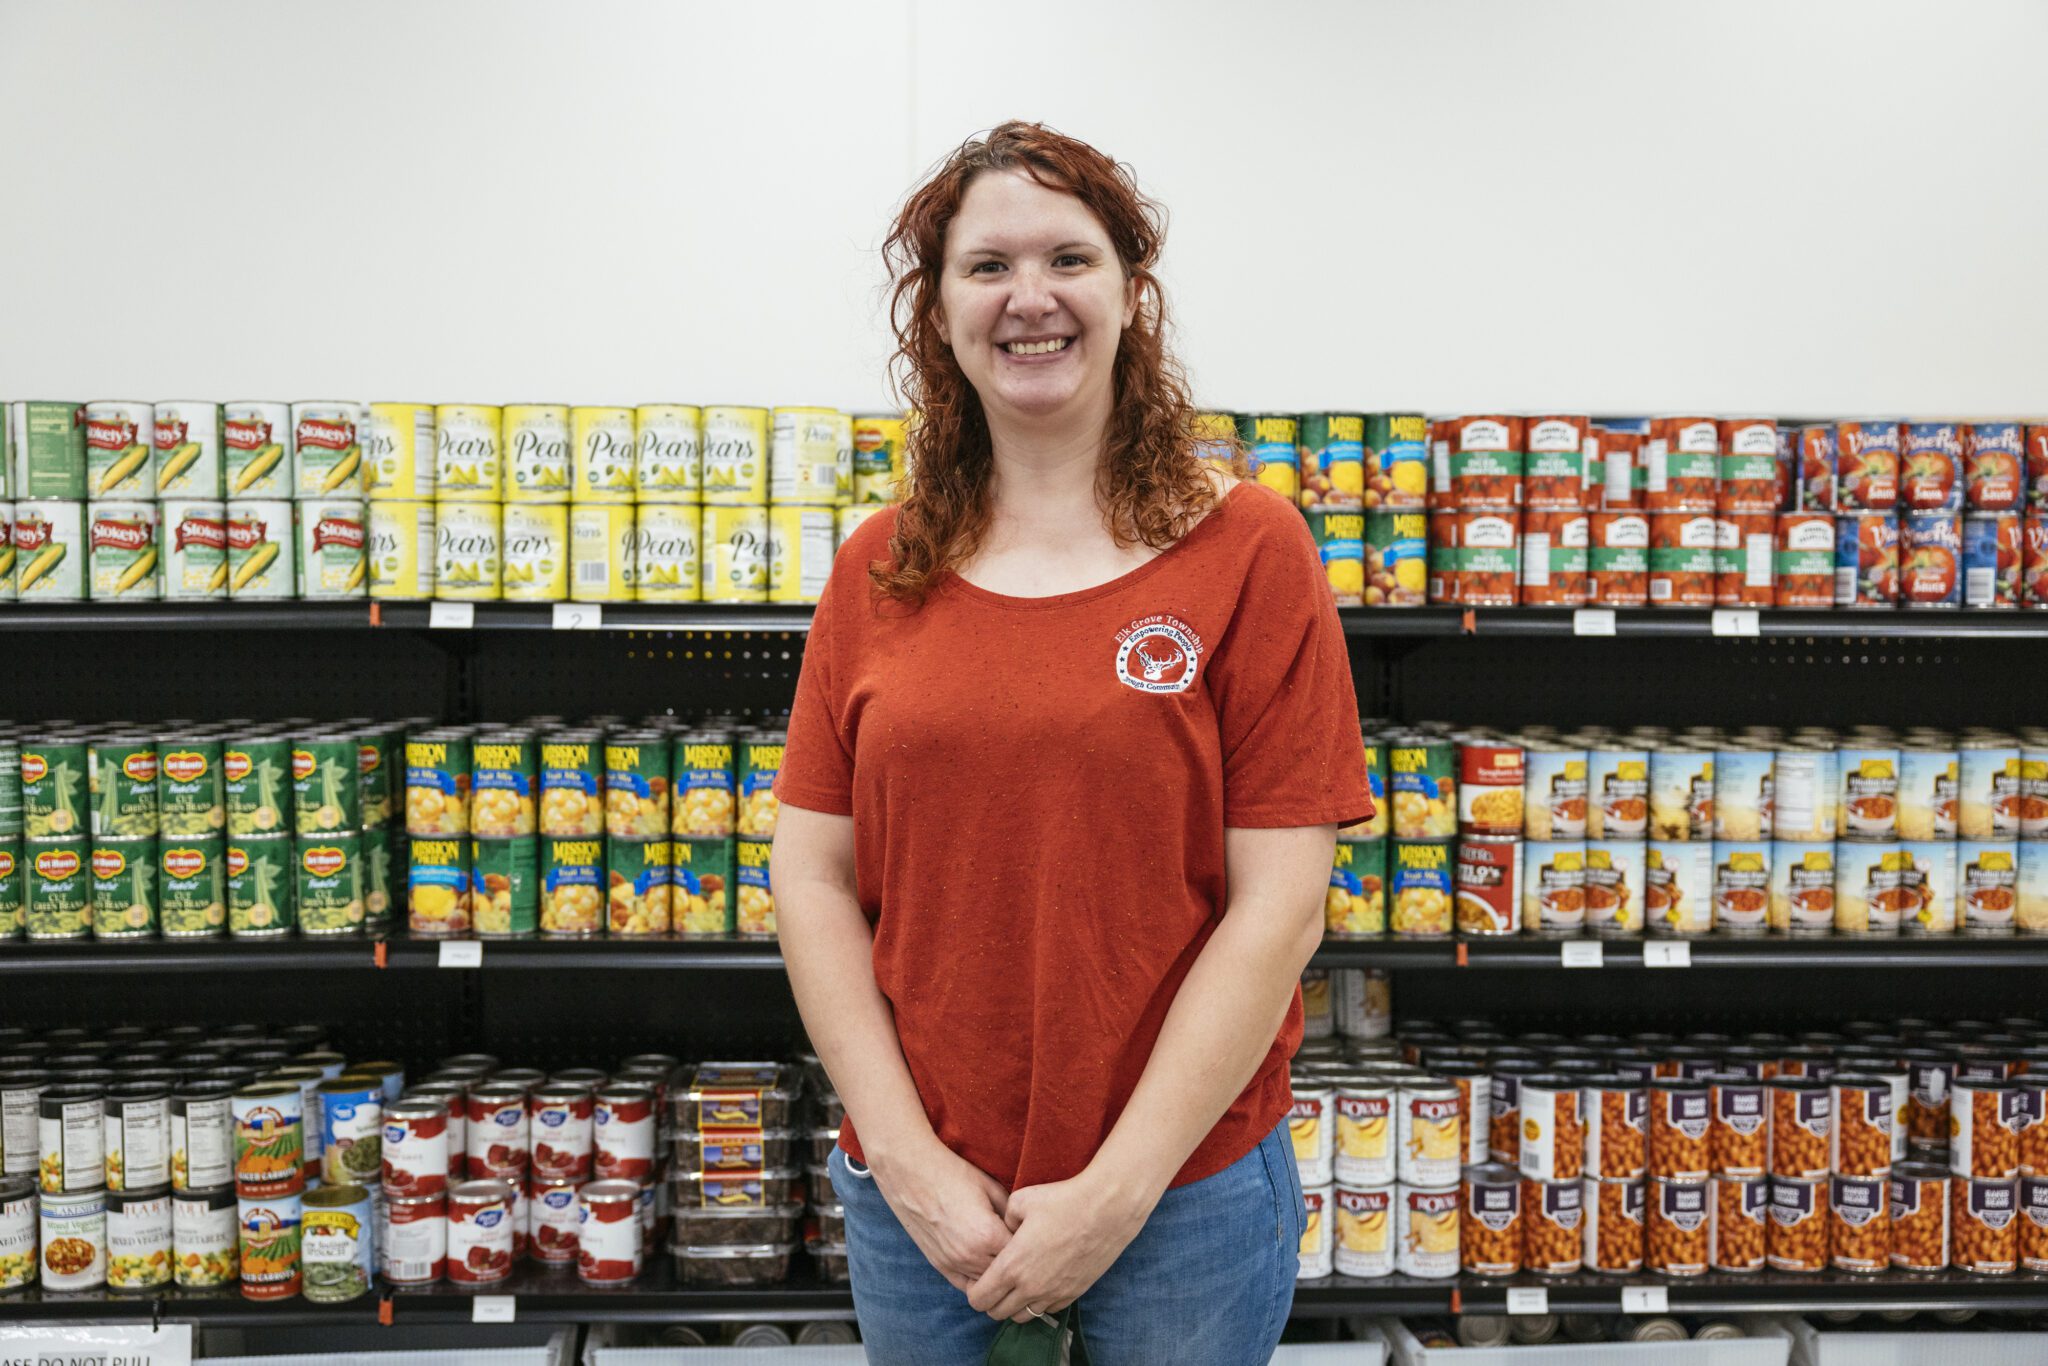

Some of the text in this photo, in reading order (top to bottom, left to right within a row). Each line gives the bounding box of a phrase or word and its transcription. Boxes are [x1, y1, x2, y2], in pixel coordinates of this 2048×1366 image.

[436, 429, 496, 461] Pears
[514, 430, 569, 463] Pear
[587, 430, 635, 463] Pea
[638, 430, 699, 462] Pears
[436, 526, 496, 560] Pears
[502, 536, 551, 554] ears
[638, 529, 695, 560] Pears
[570, 613, 582, 629] 2
[1114, 615, 1204, 655] Elk Grove Township
[1129, 626, 1192, 652] Empowering People
[473, 745, 521, 766] MISSION
[542, 745, 589, 765] MISSION
[685, 745, 732, 766] MISSION
[178, 761, 203, 771] Monte
[306, 855, 342, 866] Del Monte
[411, 840, 460, 861] MISSION
[553, 841, 602, 863] MISSION
[1398, 845, 1447, 866] MISSION
[38, 859, 77, 869] Del Monte
[178, 857, 202, 867] Monte
[1341, 1101, 1383, 1117] ROYAL
[1419, 1102, 1459, 1118] ROYA
[261, 1166, 297, 1180] CARROTS
[1341, 1196, 1382, 1211] ROYAL
[1416, 1195, 1456, 1212] ROYA
[258, 1269, 296, 1282] CARROTS
